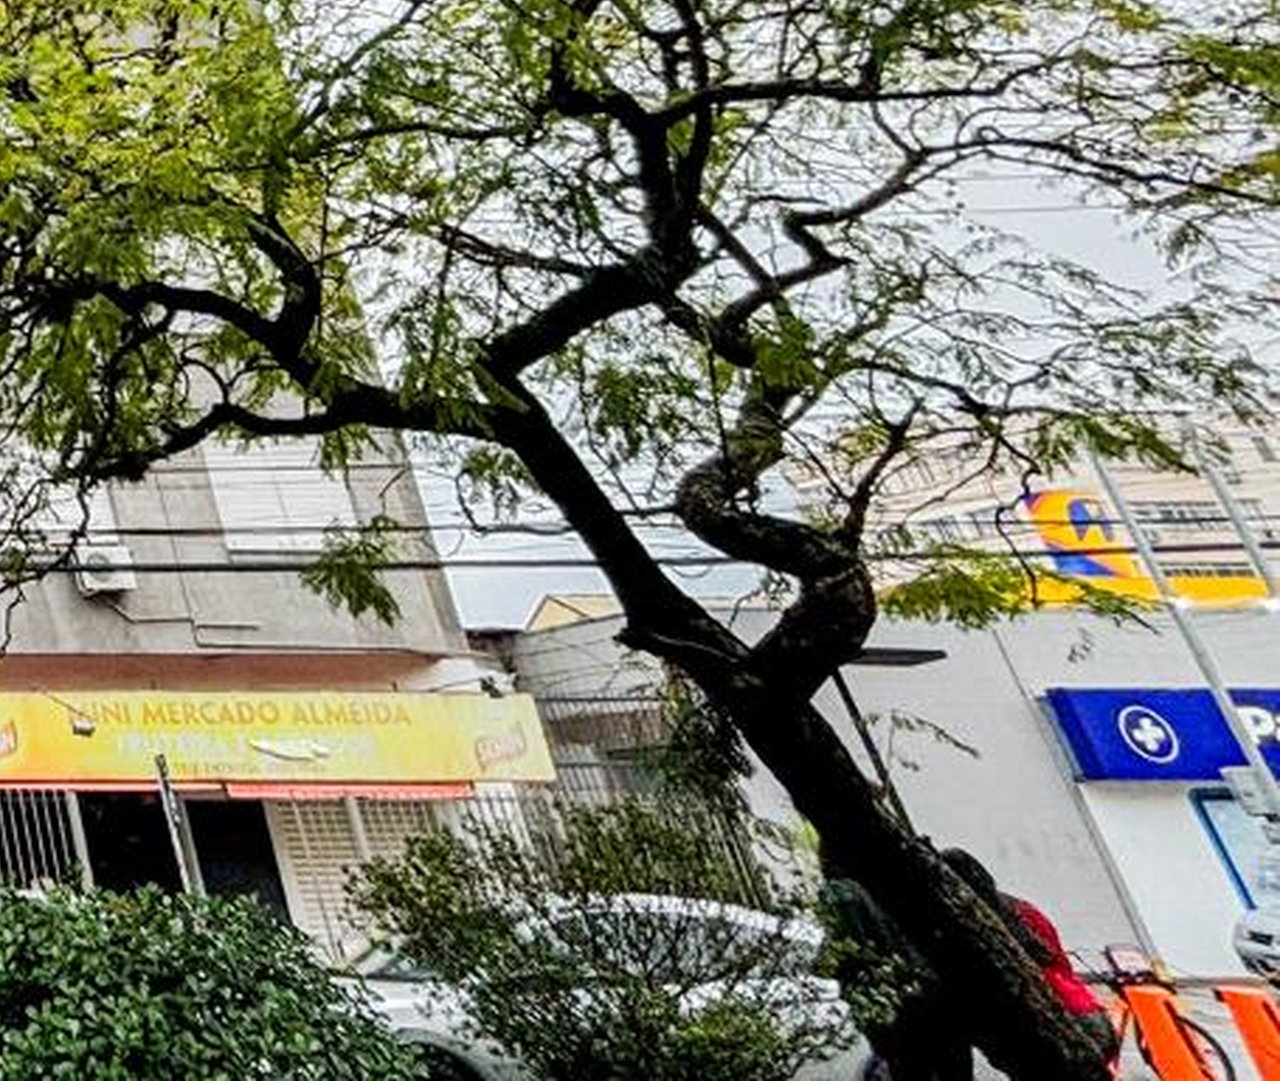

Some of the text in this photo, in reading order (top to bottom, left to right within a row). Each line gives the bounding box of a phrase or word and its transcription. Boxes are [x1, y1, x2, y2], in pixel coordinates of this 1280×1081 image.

[74, 700, 412, 725] INI MERCADO ALMEIDA
